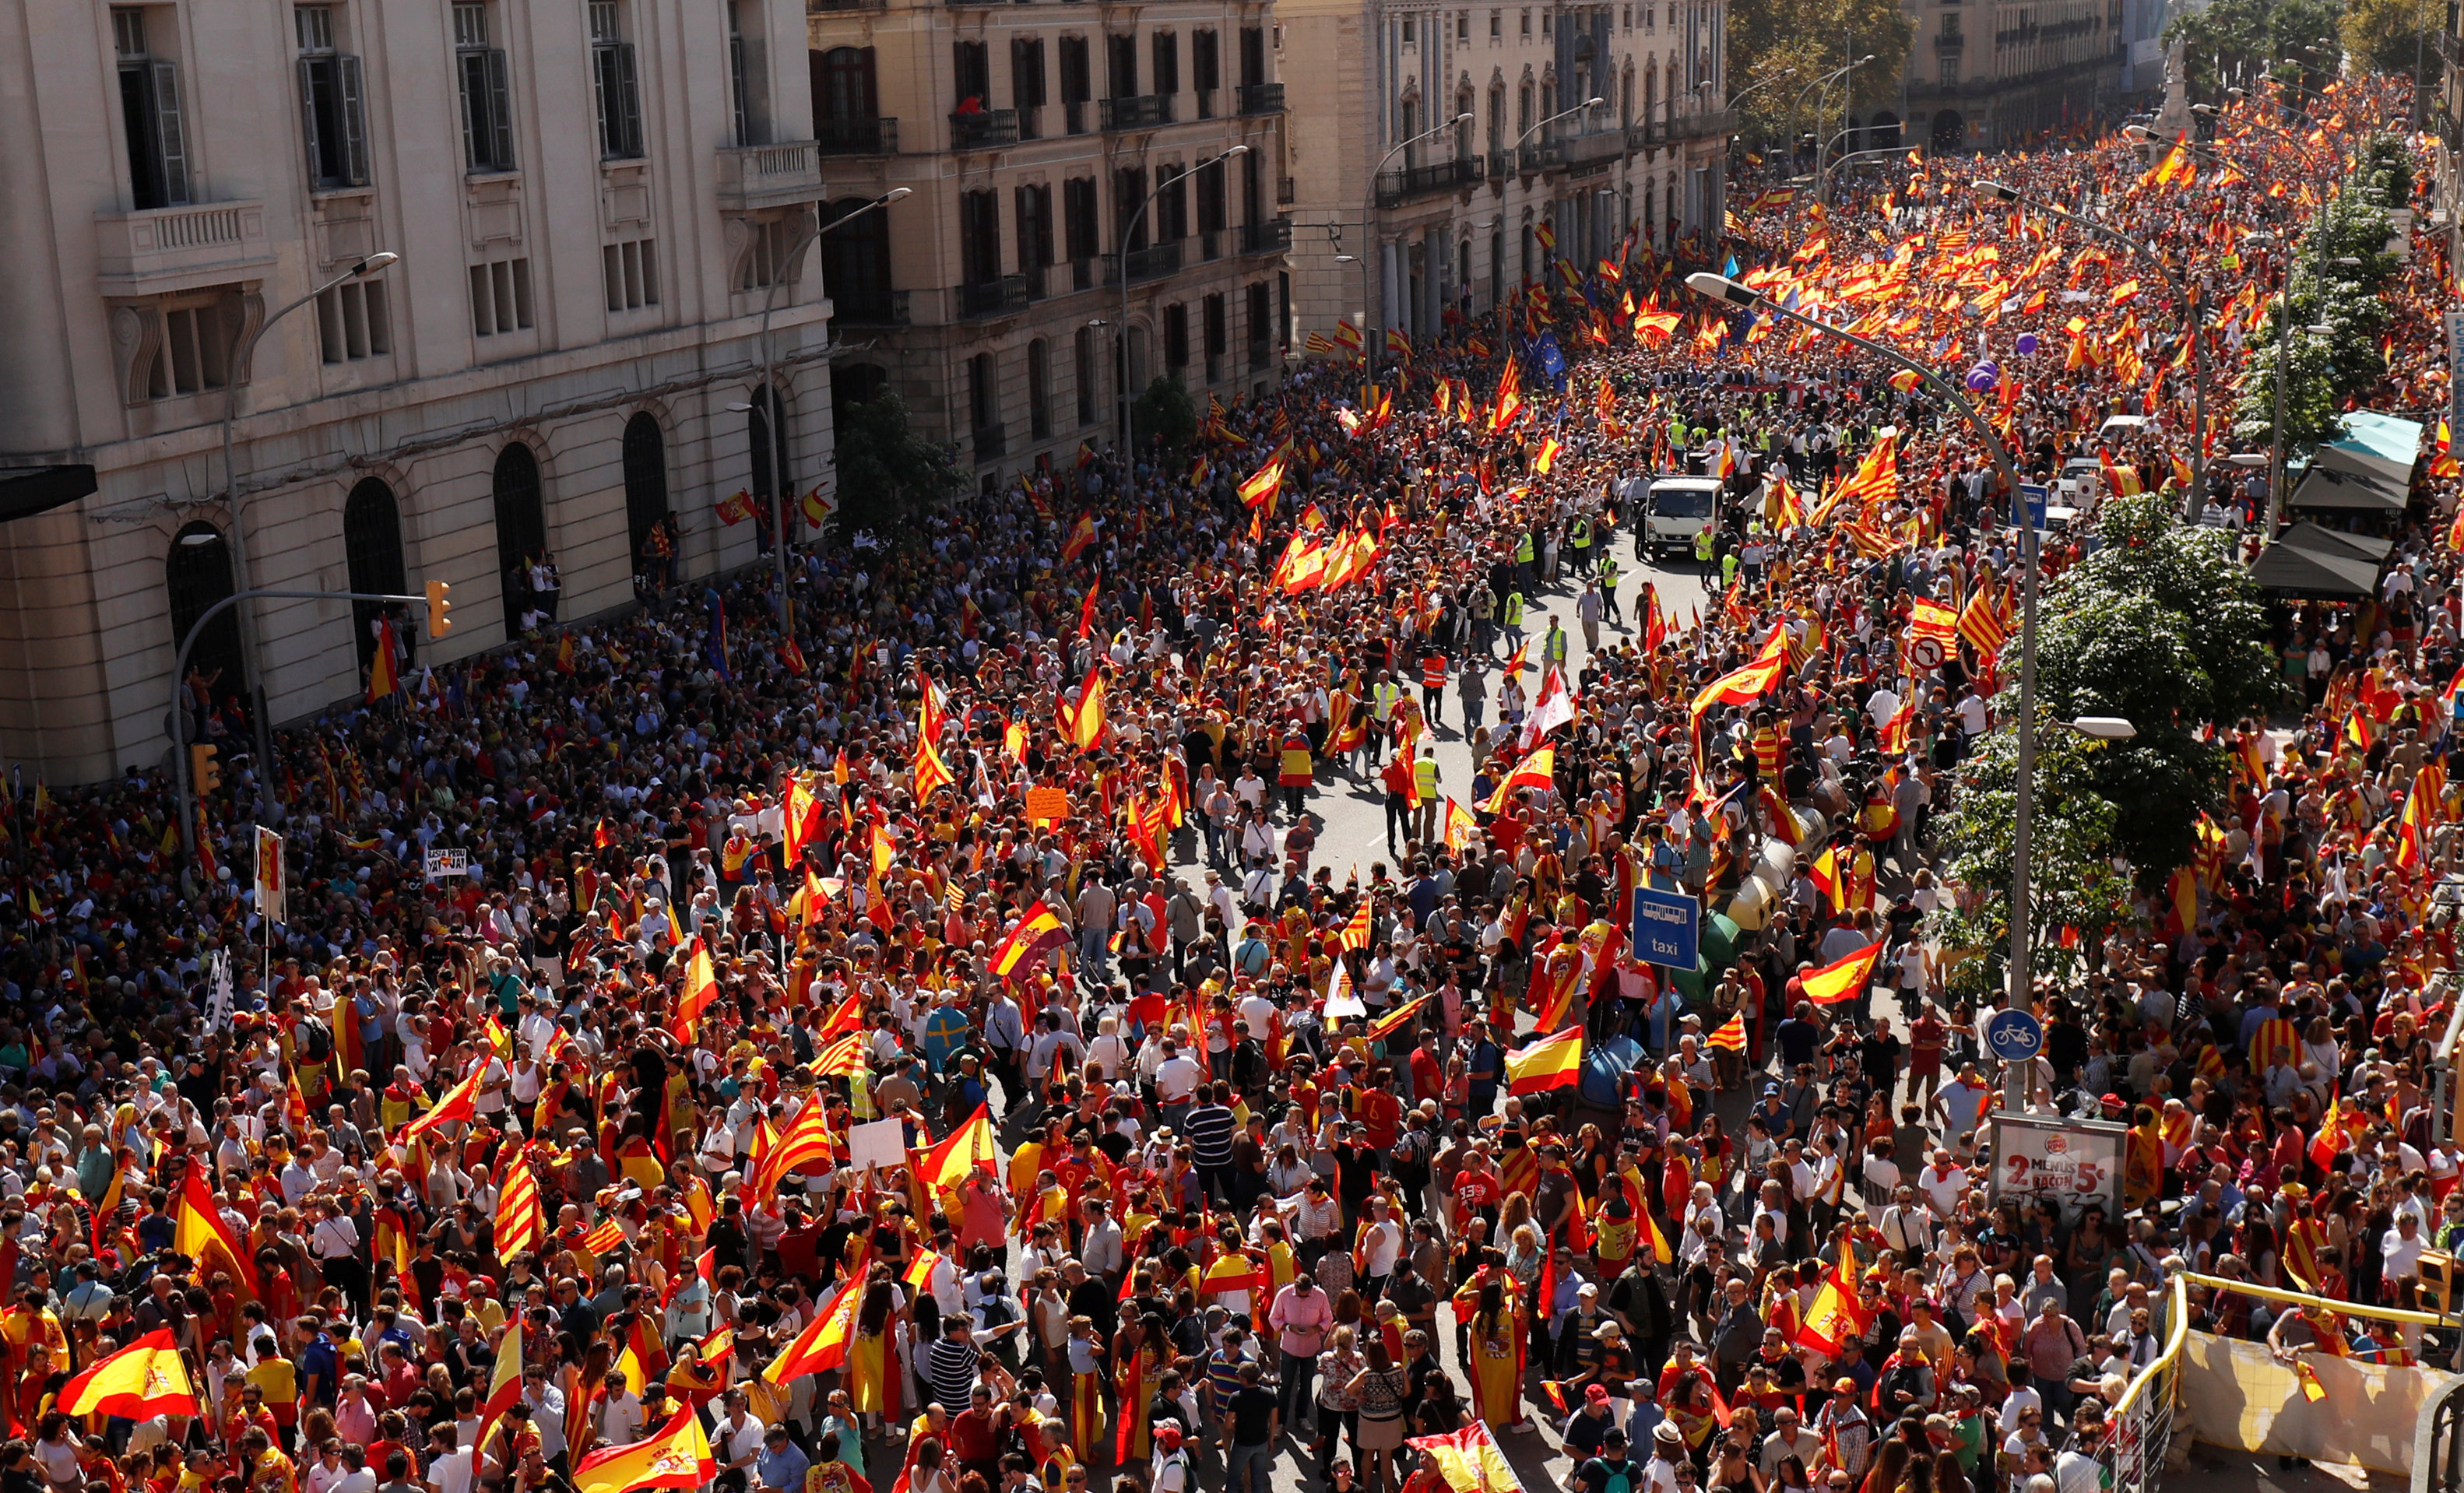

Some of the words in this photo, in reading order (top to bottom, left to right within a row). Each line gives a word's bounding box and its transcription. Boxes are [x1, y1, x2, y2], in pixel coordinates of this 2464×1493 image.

[15, 768, 20, 798] P
[1652, 937, 1678, 956] taxi
[2047, 1142, 2067, 1150] KING
[2007, 1154, 2030, 1186] 2
[2031, 1158, 2076, 1174] MENUS
[1066, 1171, 1076, 1189] 9
[2032, 1175, 2073, 1189] BACON
[1459, 1184, 1476, 1200] 93
